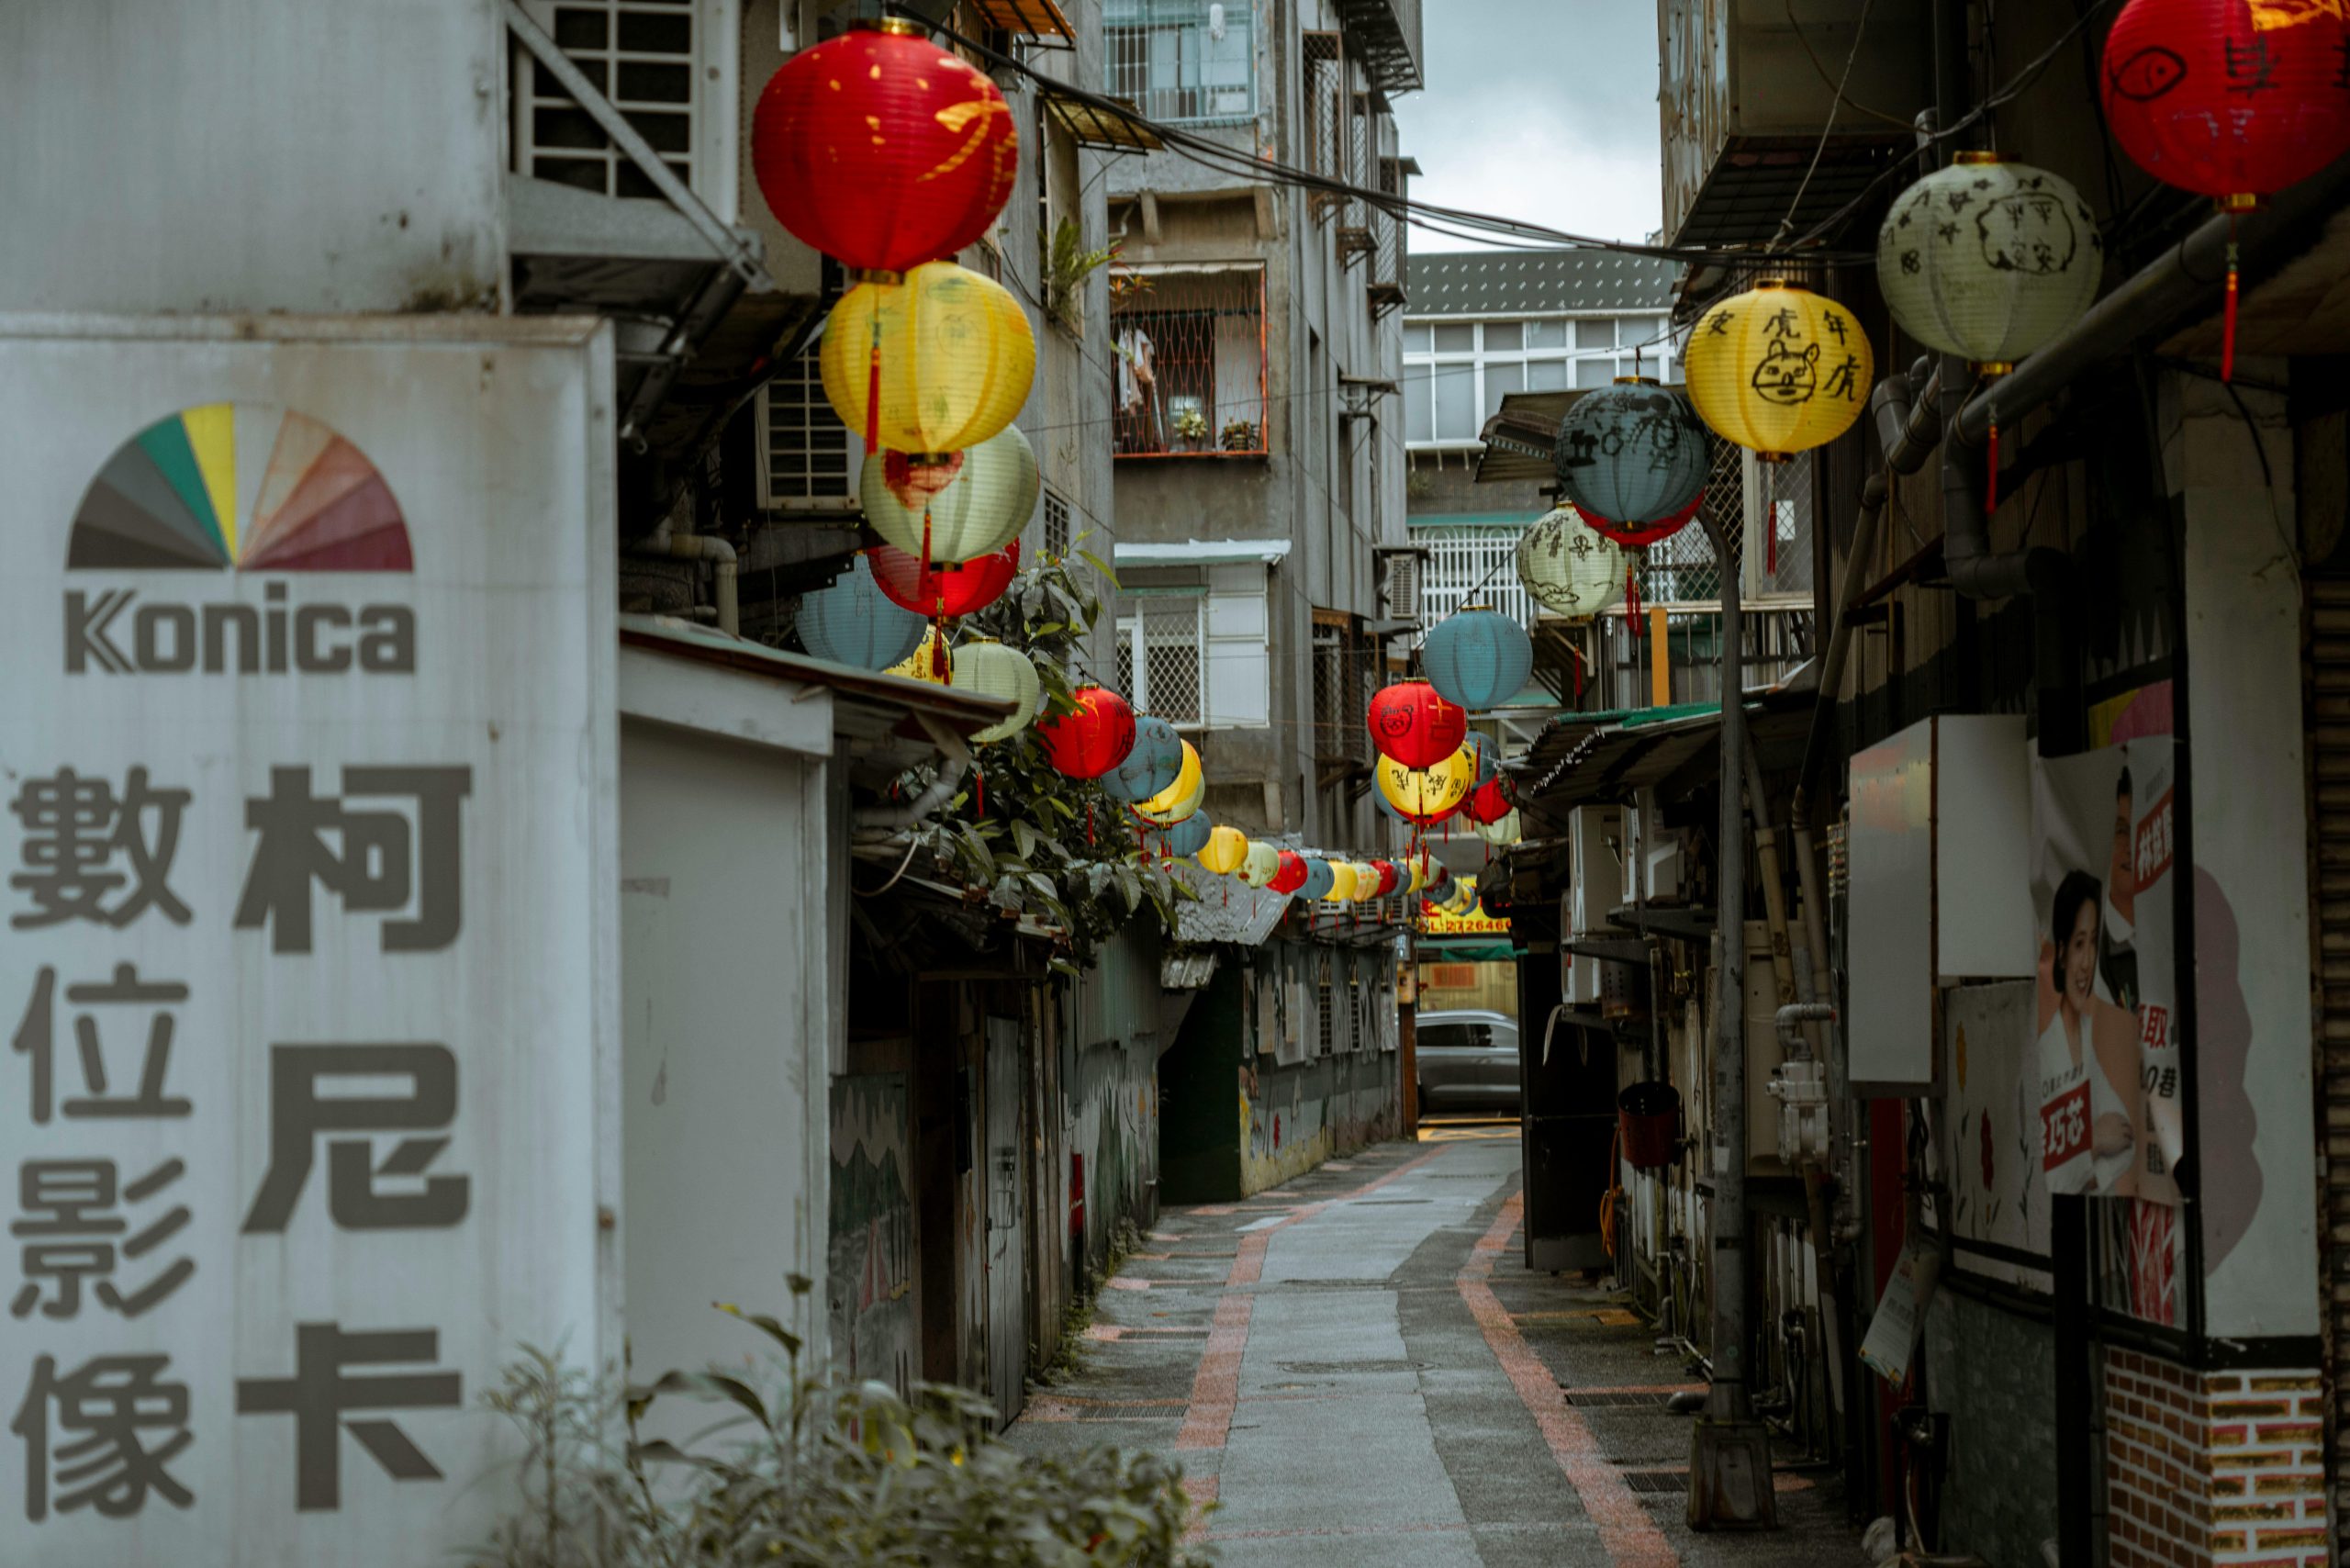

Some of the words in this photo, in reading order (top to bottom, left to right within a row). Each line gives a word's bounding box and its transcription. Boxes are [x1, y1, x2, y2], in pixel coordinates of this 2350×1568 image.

[63, 582, 417, 676] Konica
[9, 766, 196, 1524] 數位影像
[233, 764, 473, 1513] 柯尼卡
